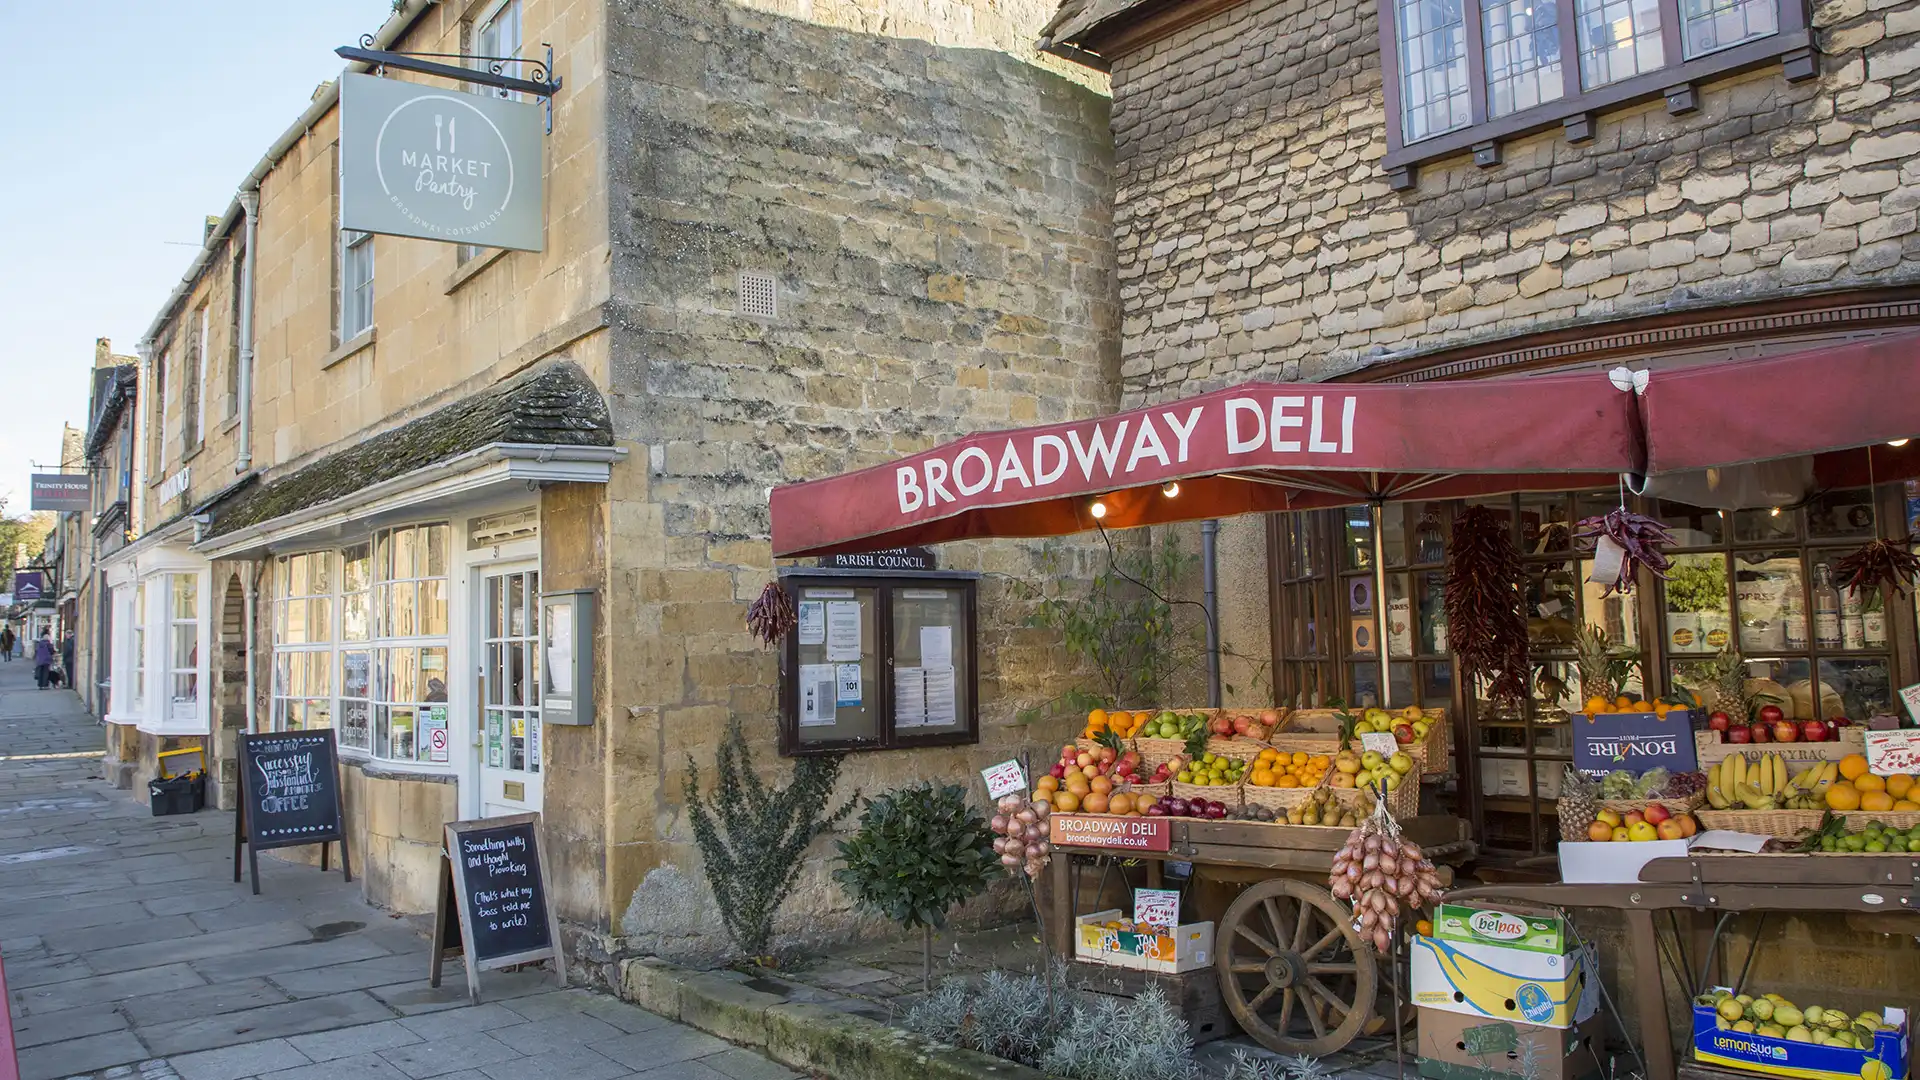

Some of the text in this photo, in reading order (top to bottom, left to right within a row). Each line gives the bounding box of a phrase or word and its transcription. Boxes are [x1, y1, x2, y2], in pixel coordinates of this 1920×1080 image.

[402, 150, 492, 178] MARKET
[415, 169, 478, 211] Pantry
[390, 195, 501, 236] BROADWAY COTSWOLDS
[896, 395, 1357, 514] BROADWAY DELI
[836, 554, 926, 569] PARISH COUNCIL
[846, 682, 857, 691] 101
[1587, 740, 1677, 757] BONAIRE
[261, 794, 309, 814] COFFEE
[1060, 819, 1157, 836] BROADWAY DELI
[464, 836, 526, 853] Something witty
[1066, 833, 1148, 846] broadwaydeli.co.uk
[468, 855, 481, 868] and
[489, 862, 527, 877] Provoking
[500, 887, 519, 898] what
[521, 887, 532, 899] my
[478, 901, 531, 917] boss told me
[489, 921, 498, 931] to
[1478, 917, 1523, 935] belpas
[1133, 934, 1158, 947] TAN
[1524, 1000, 1552, 1019] Chiquita
